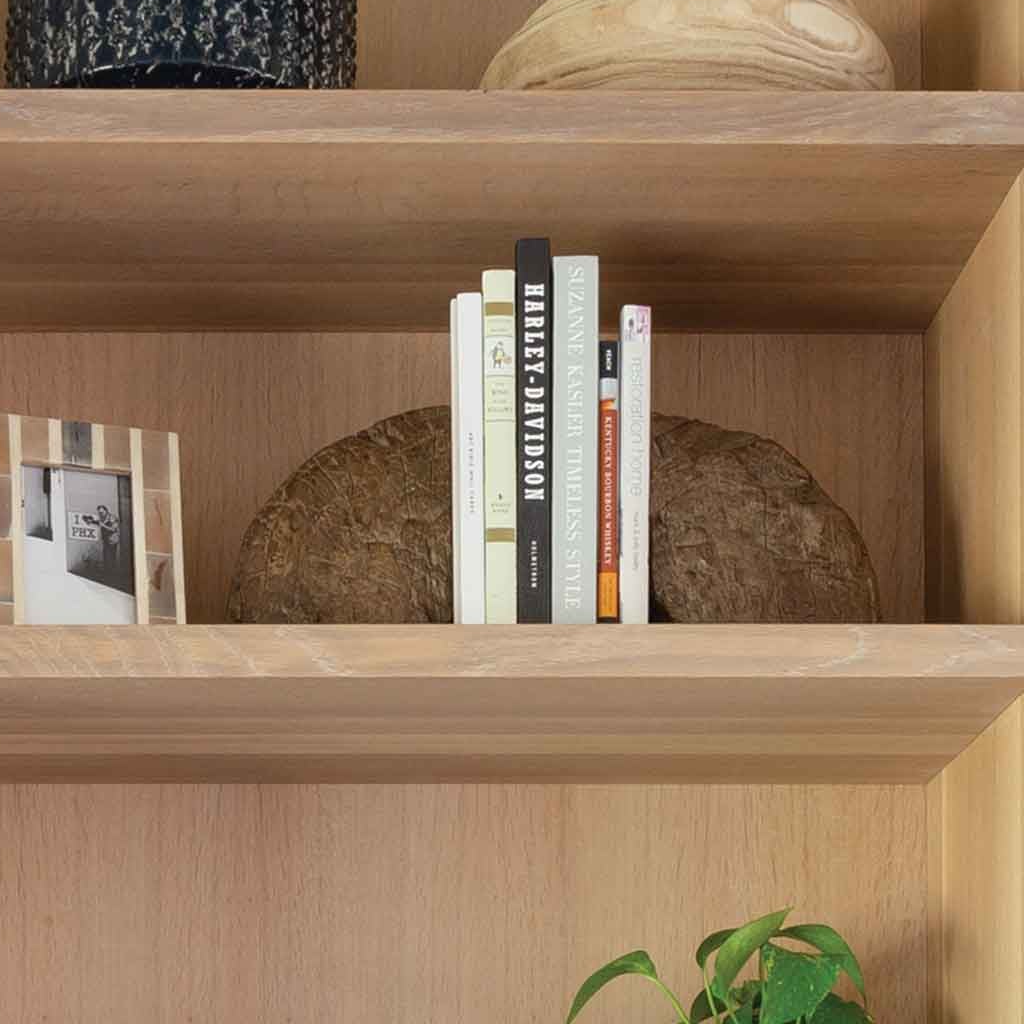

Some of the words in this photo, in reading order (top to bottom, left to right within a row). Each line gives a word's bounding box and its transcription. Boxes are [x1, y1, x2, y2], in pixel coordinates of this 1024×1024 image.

[567, 265, 585, 355] SUZANNE
[524, 283, 545, 501] HARLEY-DAVIDSON
[567, 364, 585, 438] KASLER
[630, 357, 646, 444] restoration
[604, 416, 613, 468] KENTUCKY
[566, 446, 584, 541] TIMELESS
[604, 472, 613, 519] BOURBON
[630, 447, 646, 497] home
[71, 526, 96, 539] PHX
[74, 514, 80, 525] I
[603, 521, 613, 565] WHISKEY
[565, 549, 583, 609] STYLE
